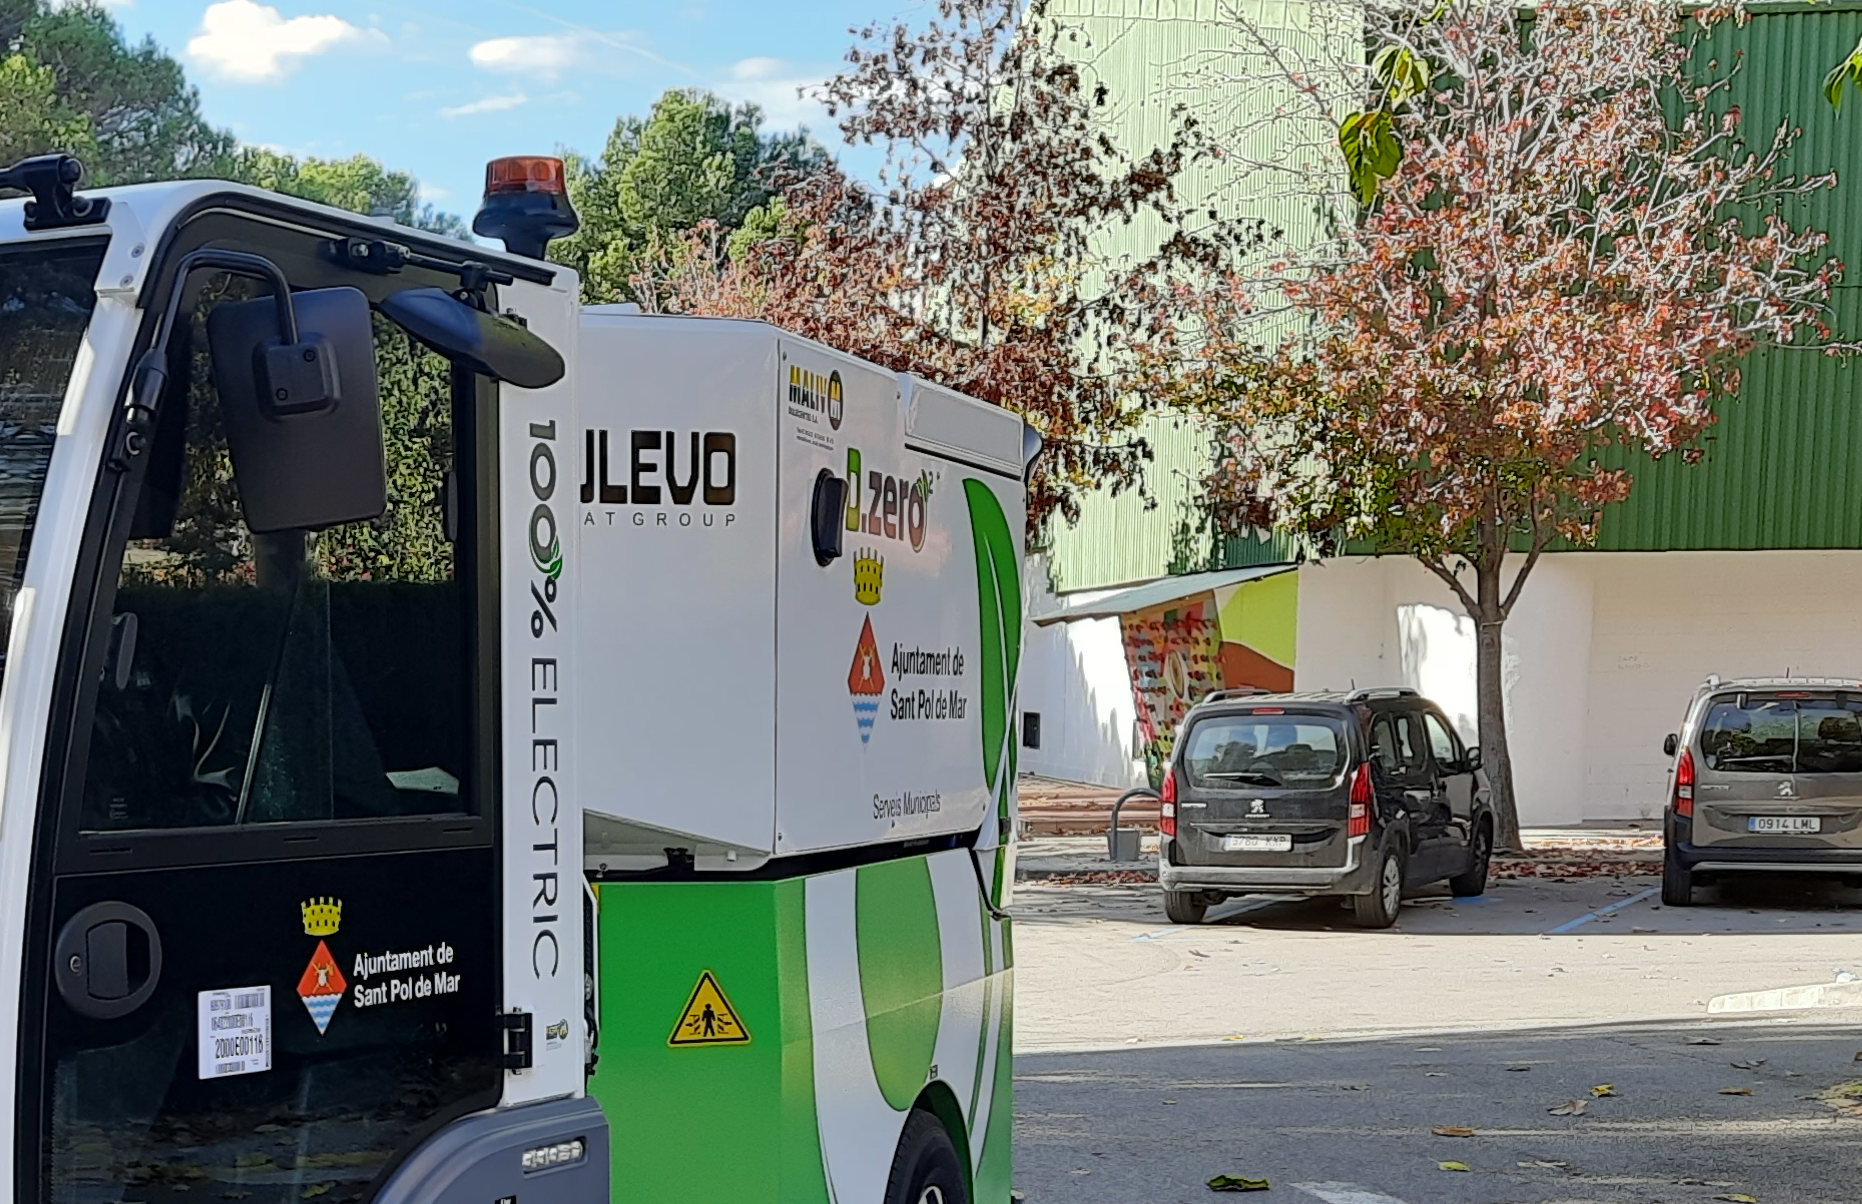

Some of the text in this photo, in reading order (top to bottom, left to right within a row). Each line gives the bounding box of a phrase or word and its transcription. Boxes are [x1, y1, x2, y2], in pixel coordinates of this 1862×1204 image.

[633, 512, 736, 527] GROUP
[891, 642, 964, 681] Ajuntament de
[890, 688, 967, 720] Sant Pol de Mar
[531, 658, 558, 979] ELECTRIC
[1758, 818, 1816, 830] 0914 LML
[353, 941, 454, 981] Ajuntament de
[354, 970, 461, 1008] Sant Pol de Mar
